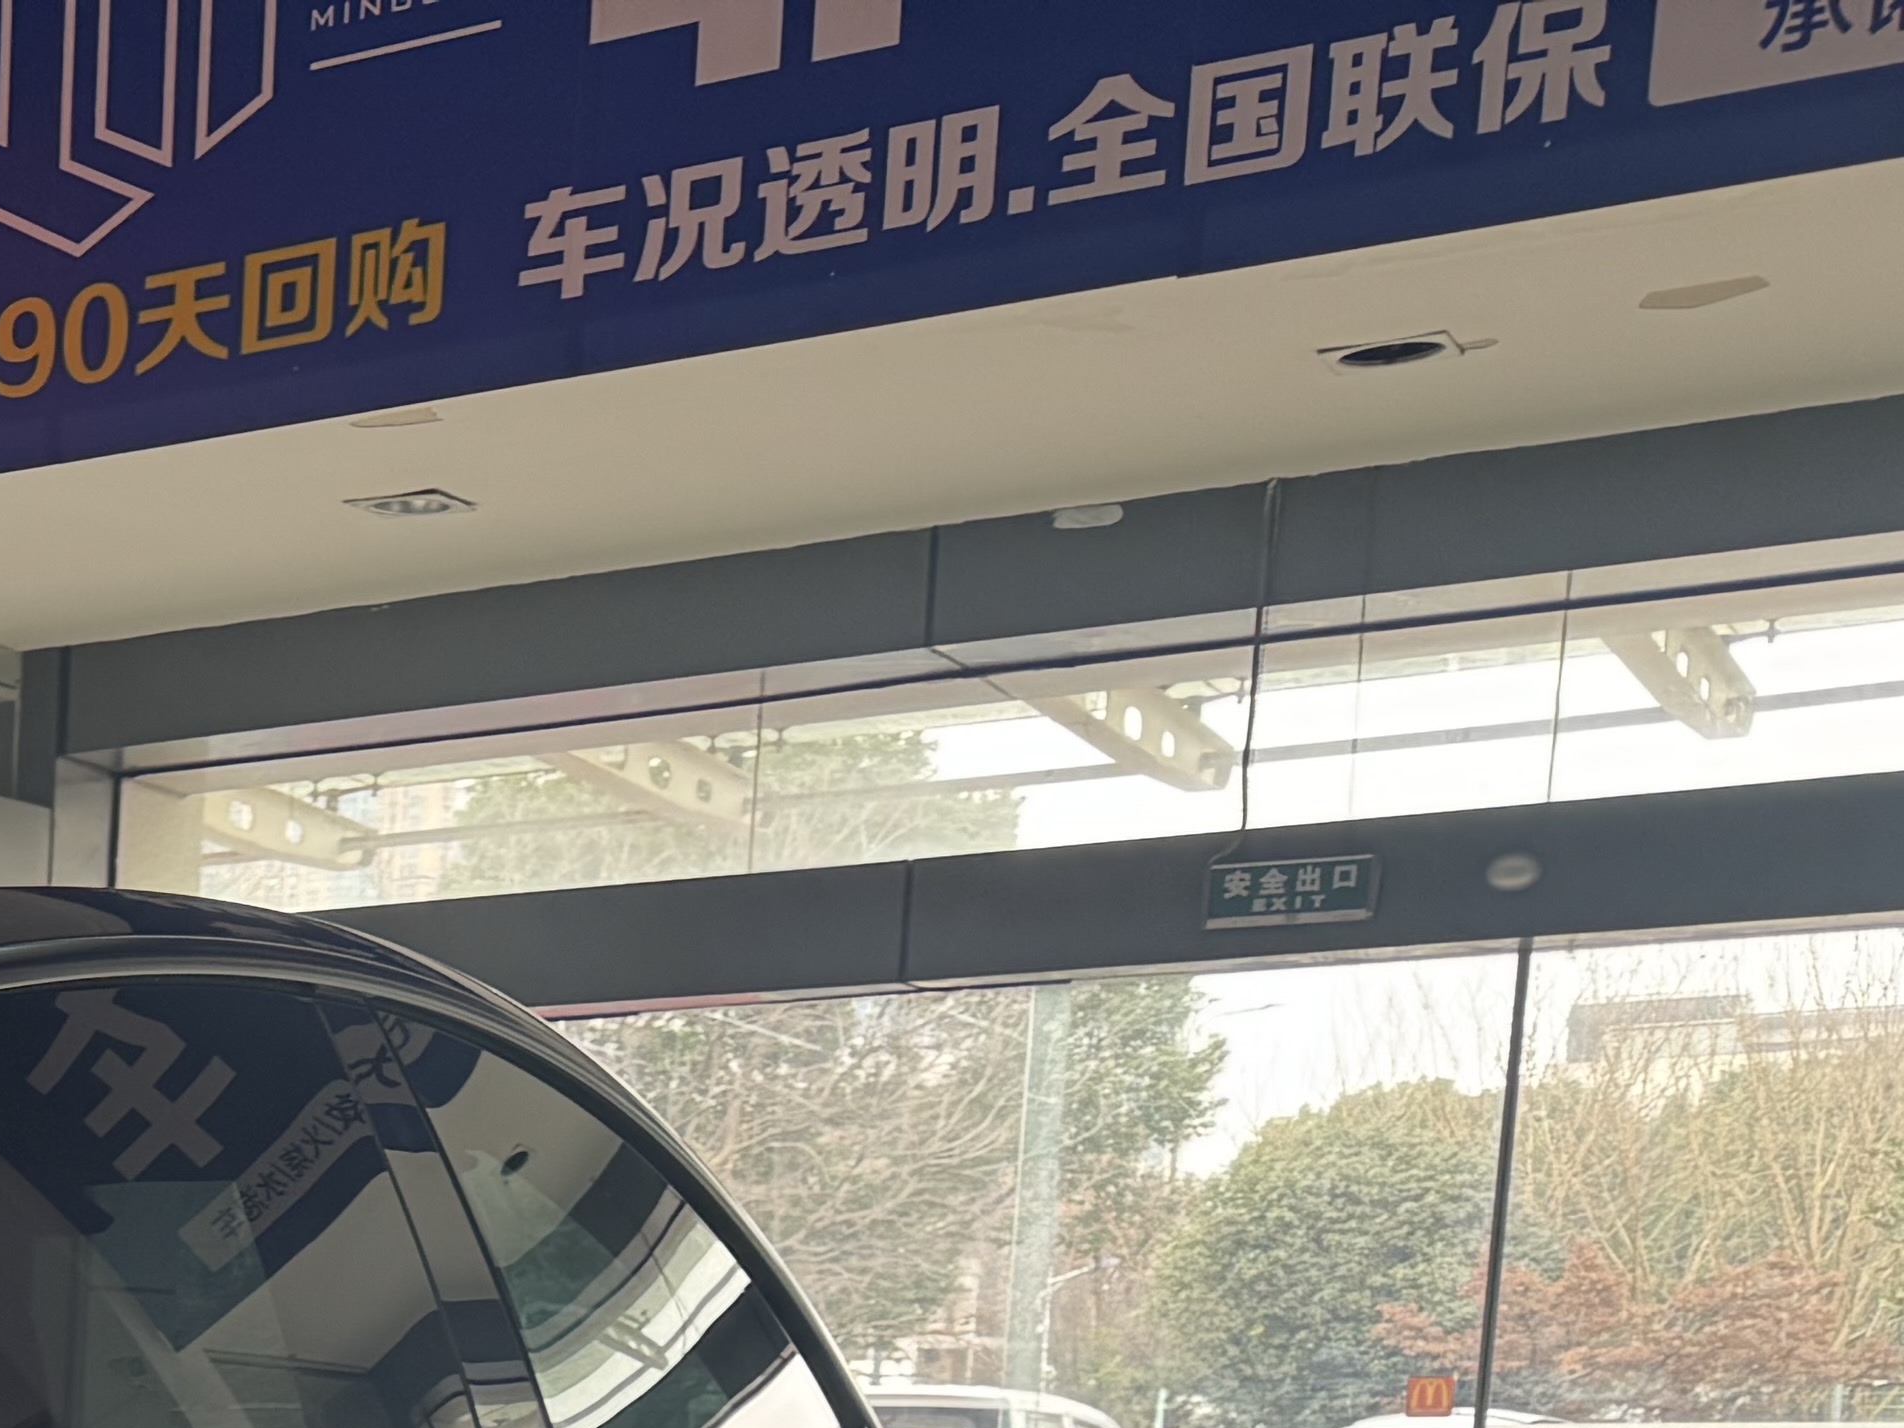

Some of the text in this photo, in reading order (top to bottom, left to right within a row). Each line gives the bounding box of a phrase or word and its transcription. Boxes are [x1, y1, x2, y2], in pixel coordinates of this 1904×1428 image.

[518, 1, 1612, 300] 车况透明.全国联保
[1223, 864, 1359, 899] 安全出口
[1251, 895, 1327, 912] EXIT
